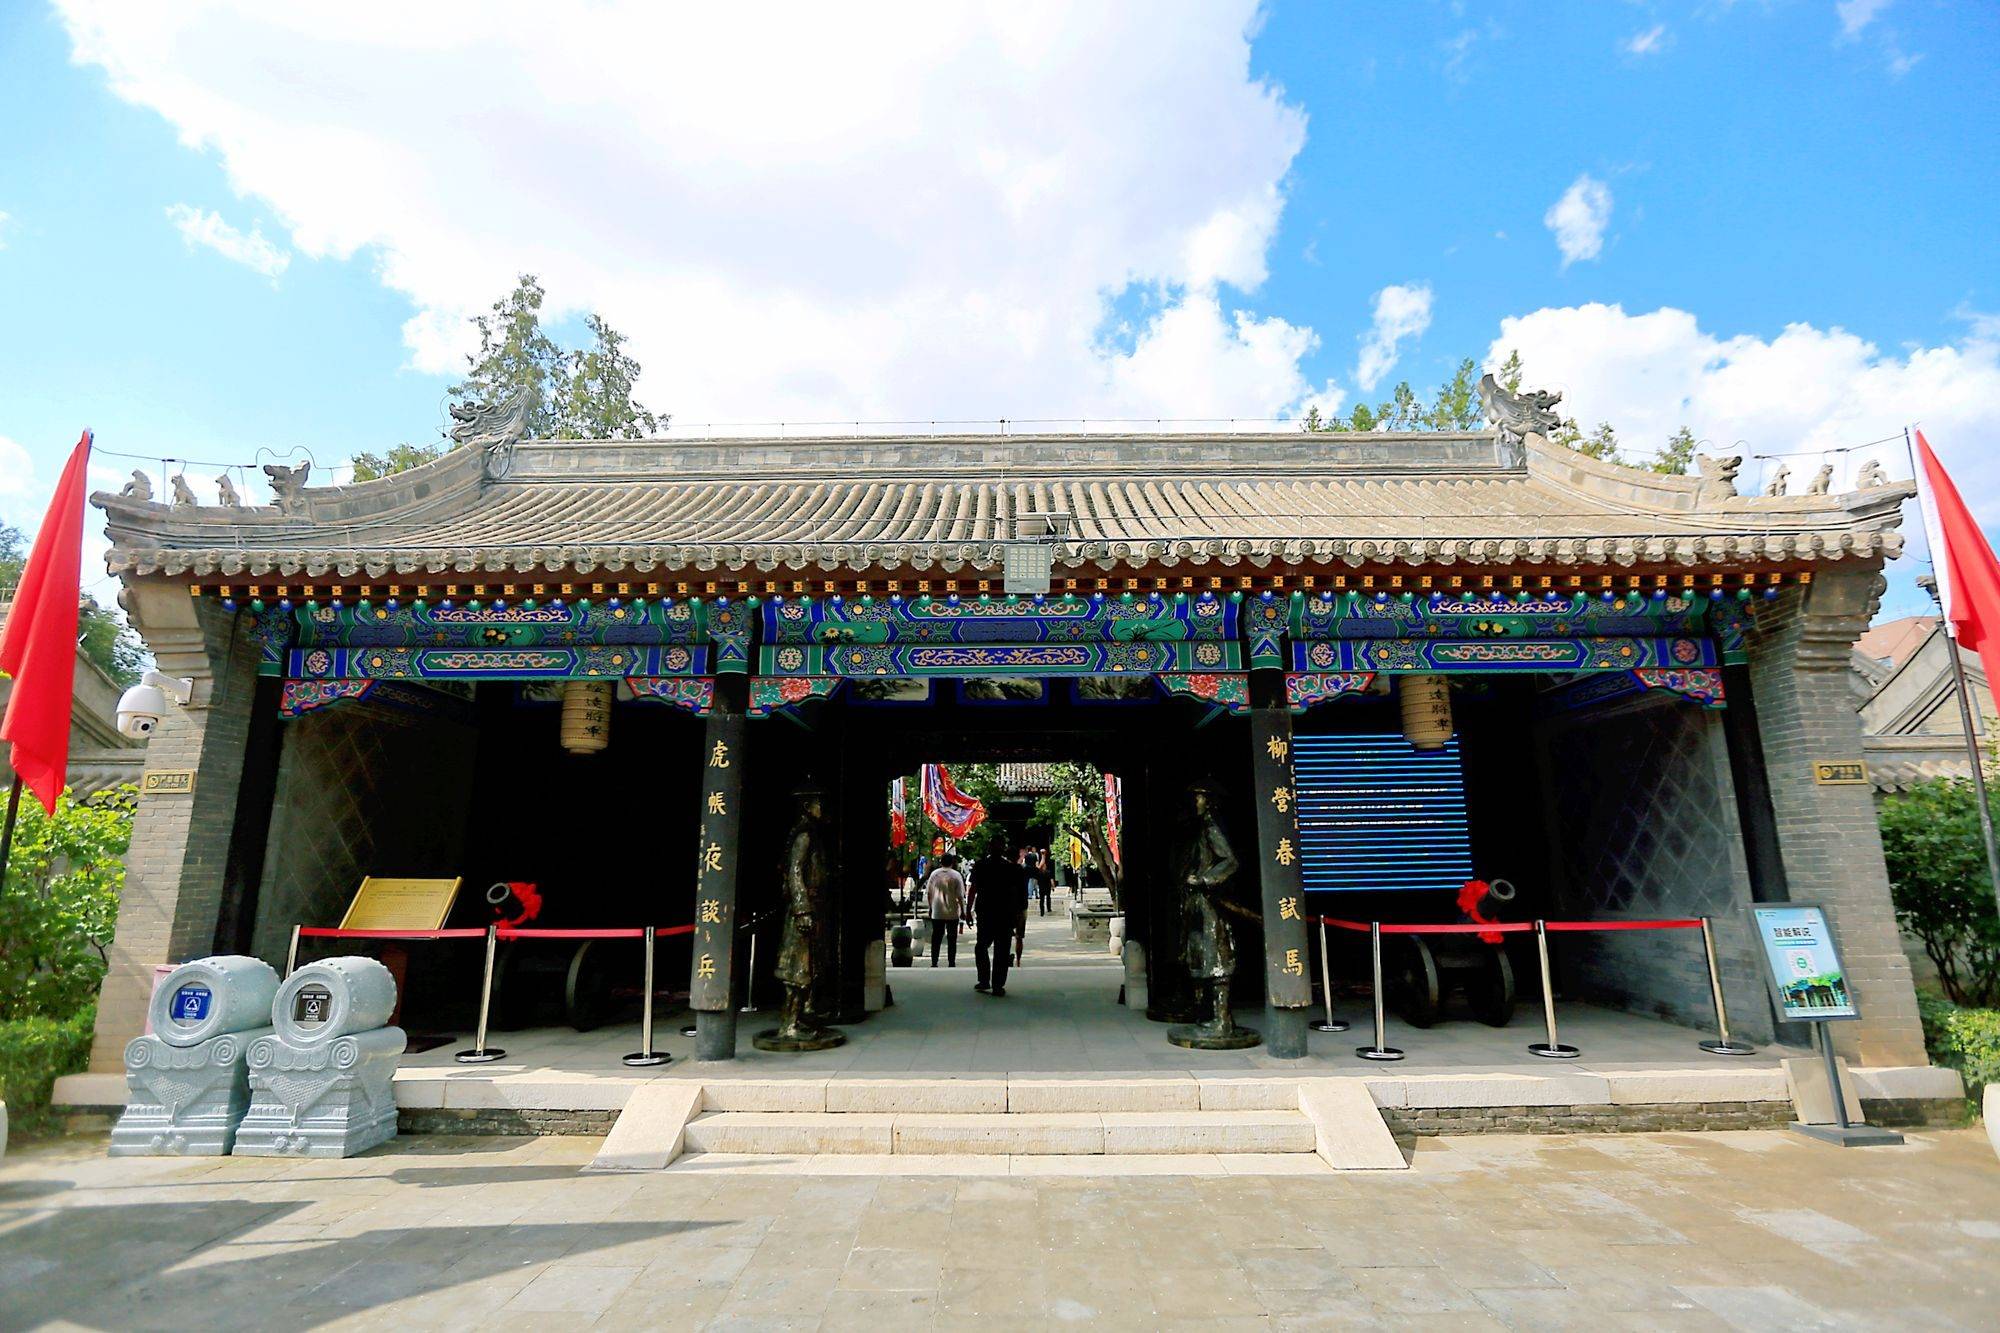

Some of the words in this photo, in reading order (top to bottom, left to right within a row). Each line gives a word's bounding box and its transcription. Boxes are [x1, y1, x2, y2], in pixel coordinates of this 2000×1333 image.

[697, 739, 730, 980] 虎帳夜談兵
[1266, 735, 1304, 977] 柳營春試馬
